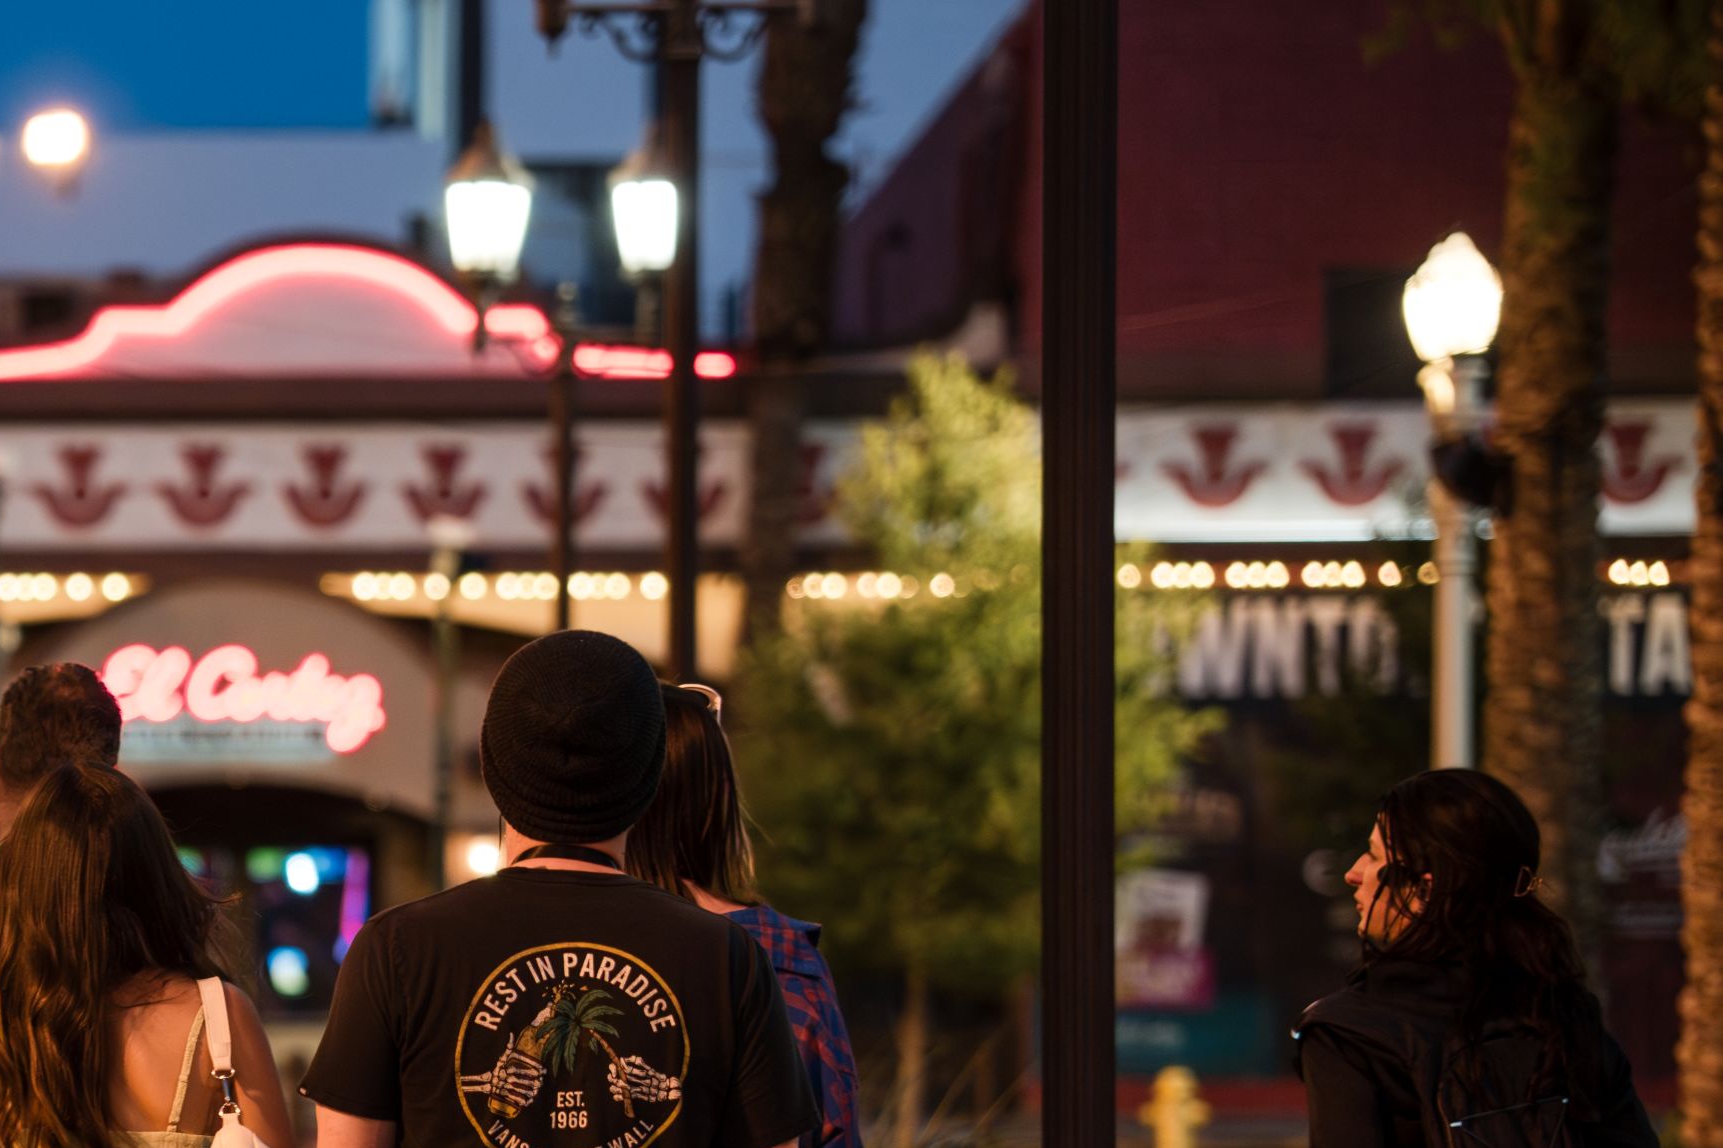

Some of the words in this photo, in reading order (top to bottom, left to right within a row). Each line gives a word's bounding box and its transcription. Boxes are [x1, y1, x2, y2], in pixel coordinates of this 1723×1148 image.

[103, 644, 190, 722] El
[473, 968, 527, 1031] REST
[526, 955, 556, 984] IN
[563, 952, 677, 1033] PARADISE
[549, 1110, 589, 1129] 1966
[556, 1091, 586, 1108] EST.
